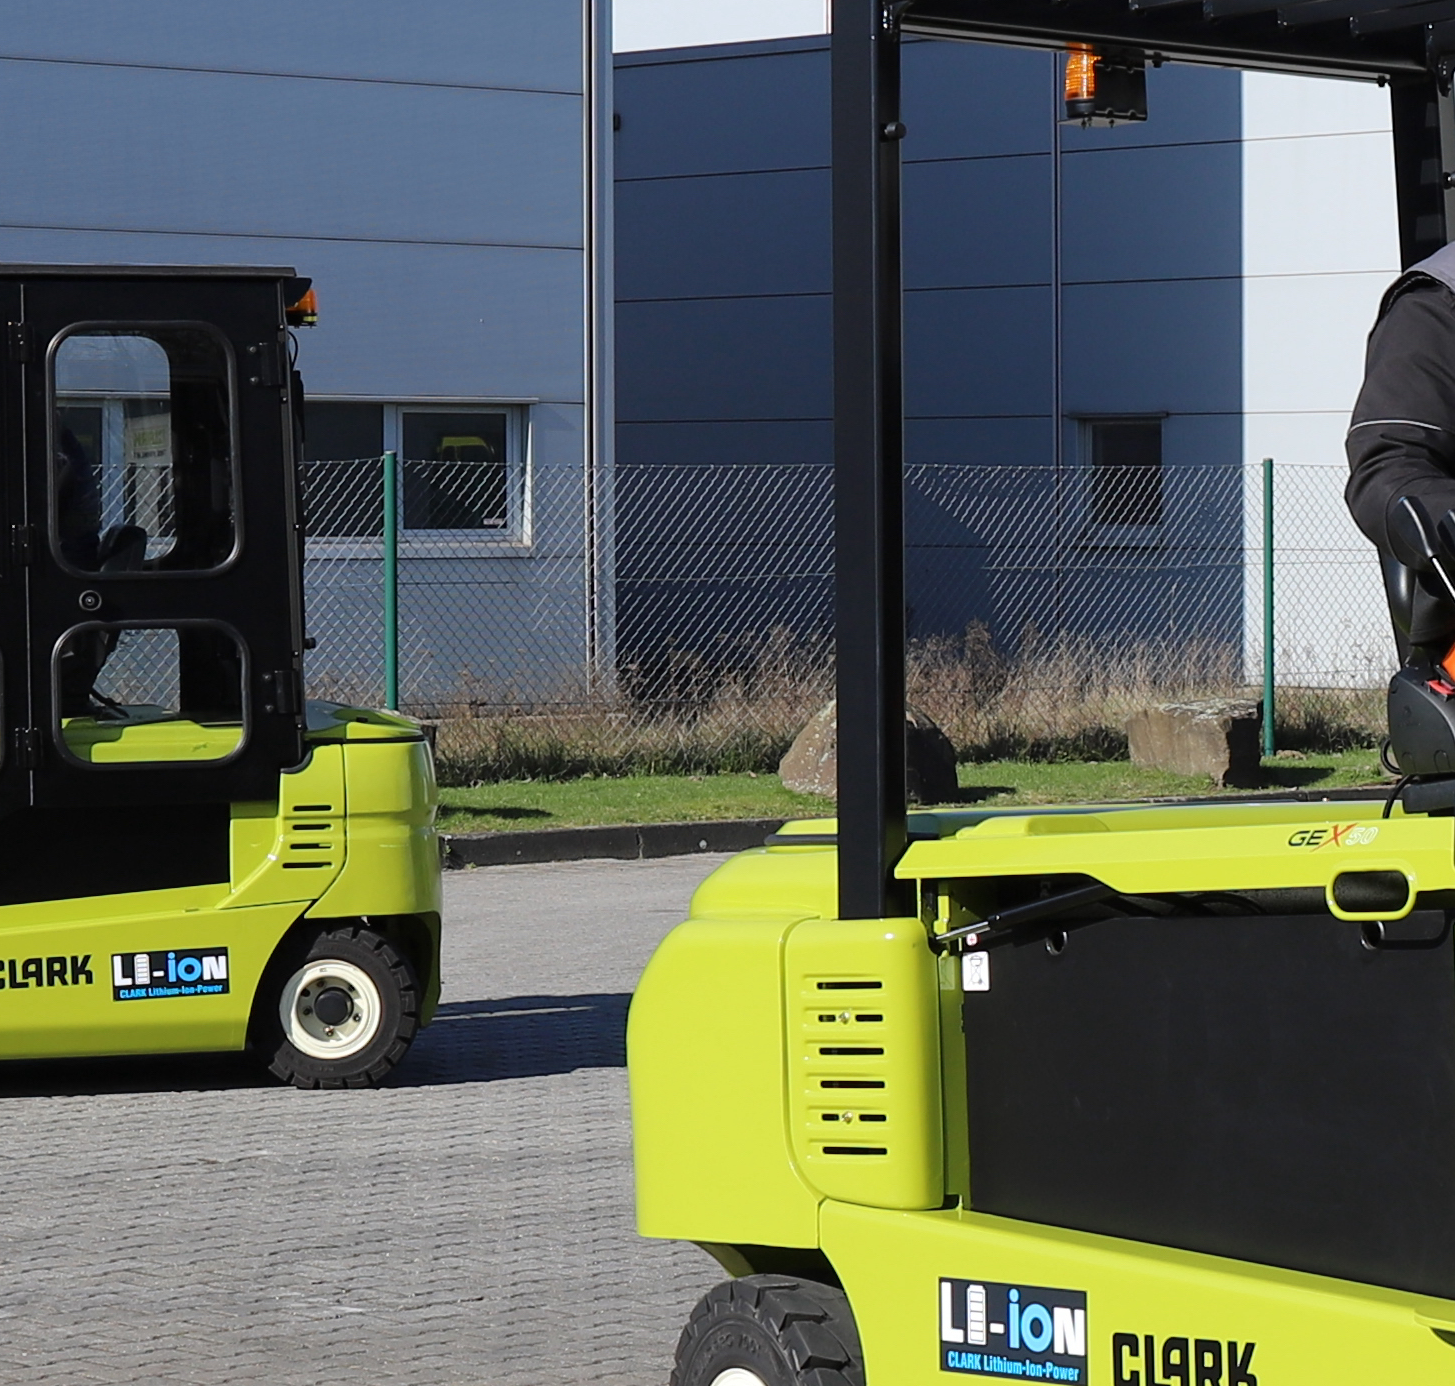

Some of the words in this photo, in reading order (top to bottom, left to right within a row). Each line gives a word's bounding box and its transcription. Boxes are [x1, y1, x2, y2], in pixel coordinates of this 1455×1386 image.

[119, 988, 147, 999] CLARK
[947, 1350, 982, 1371] CLARK
[983, 1354, 1080, 1382] Lithium-Ion-Power
